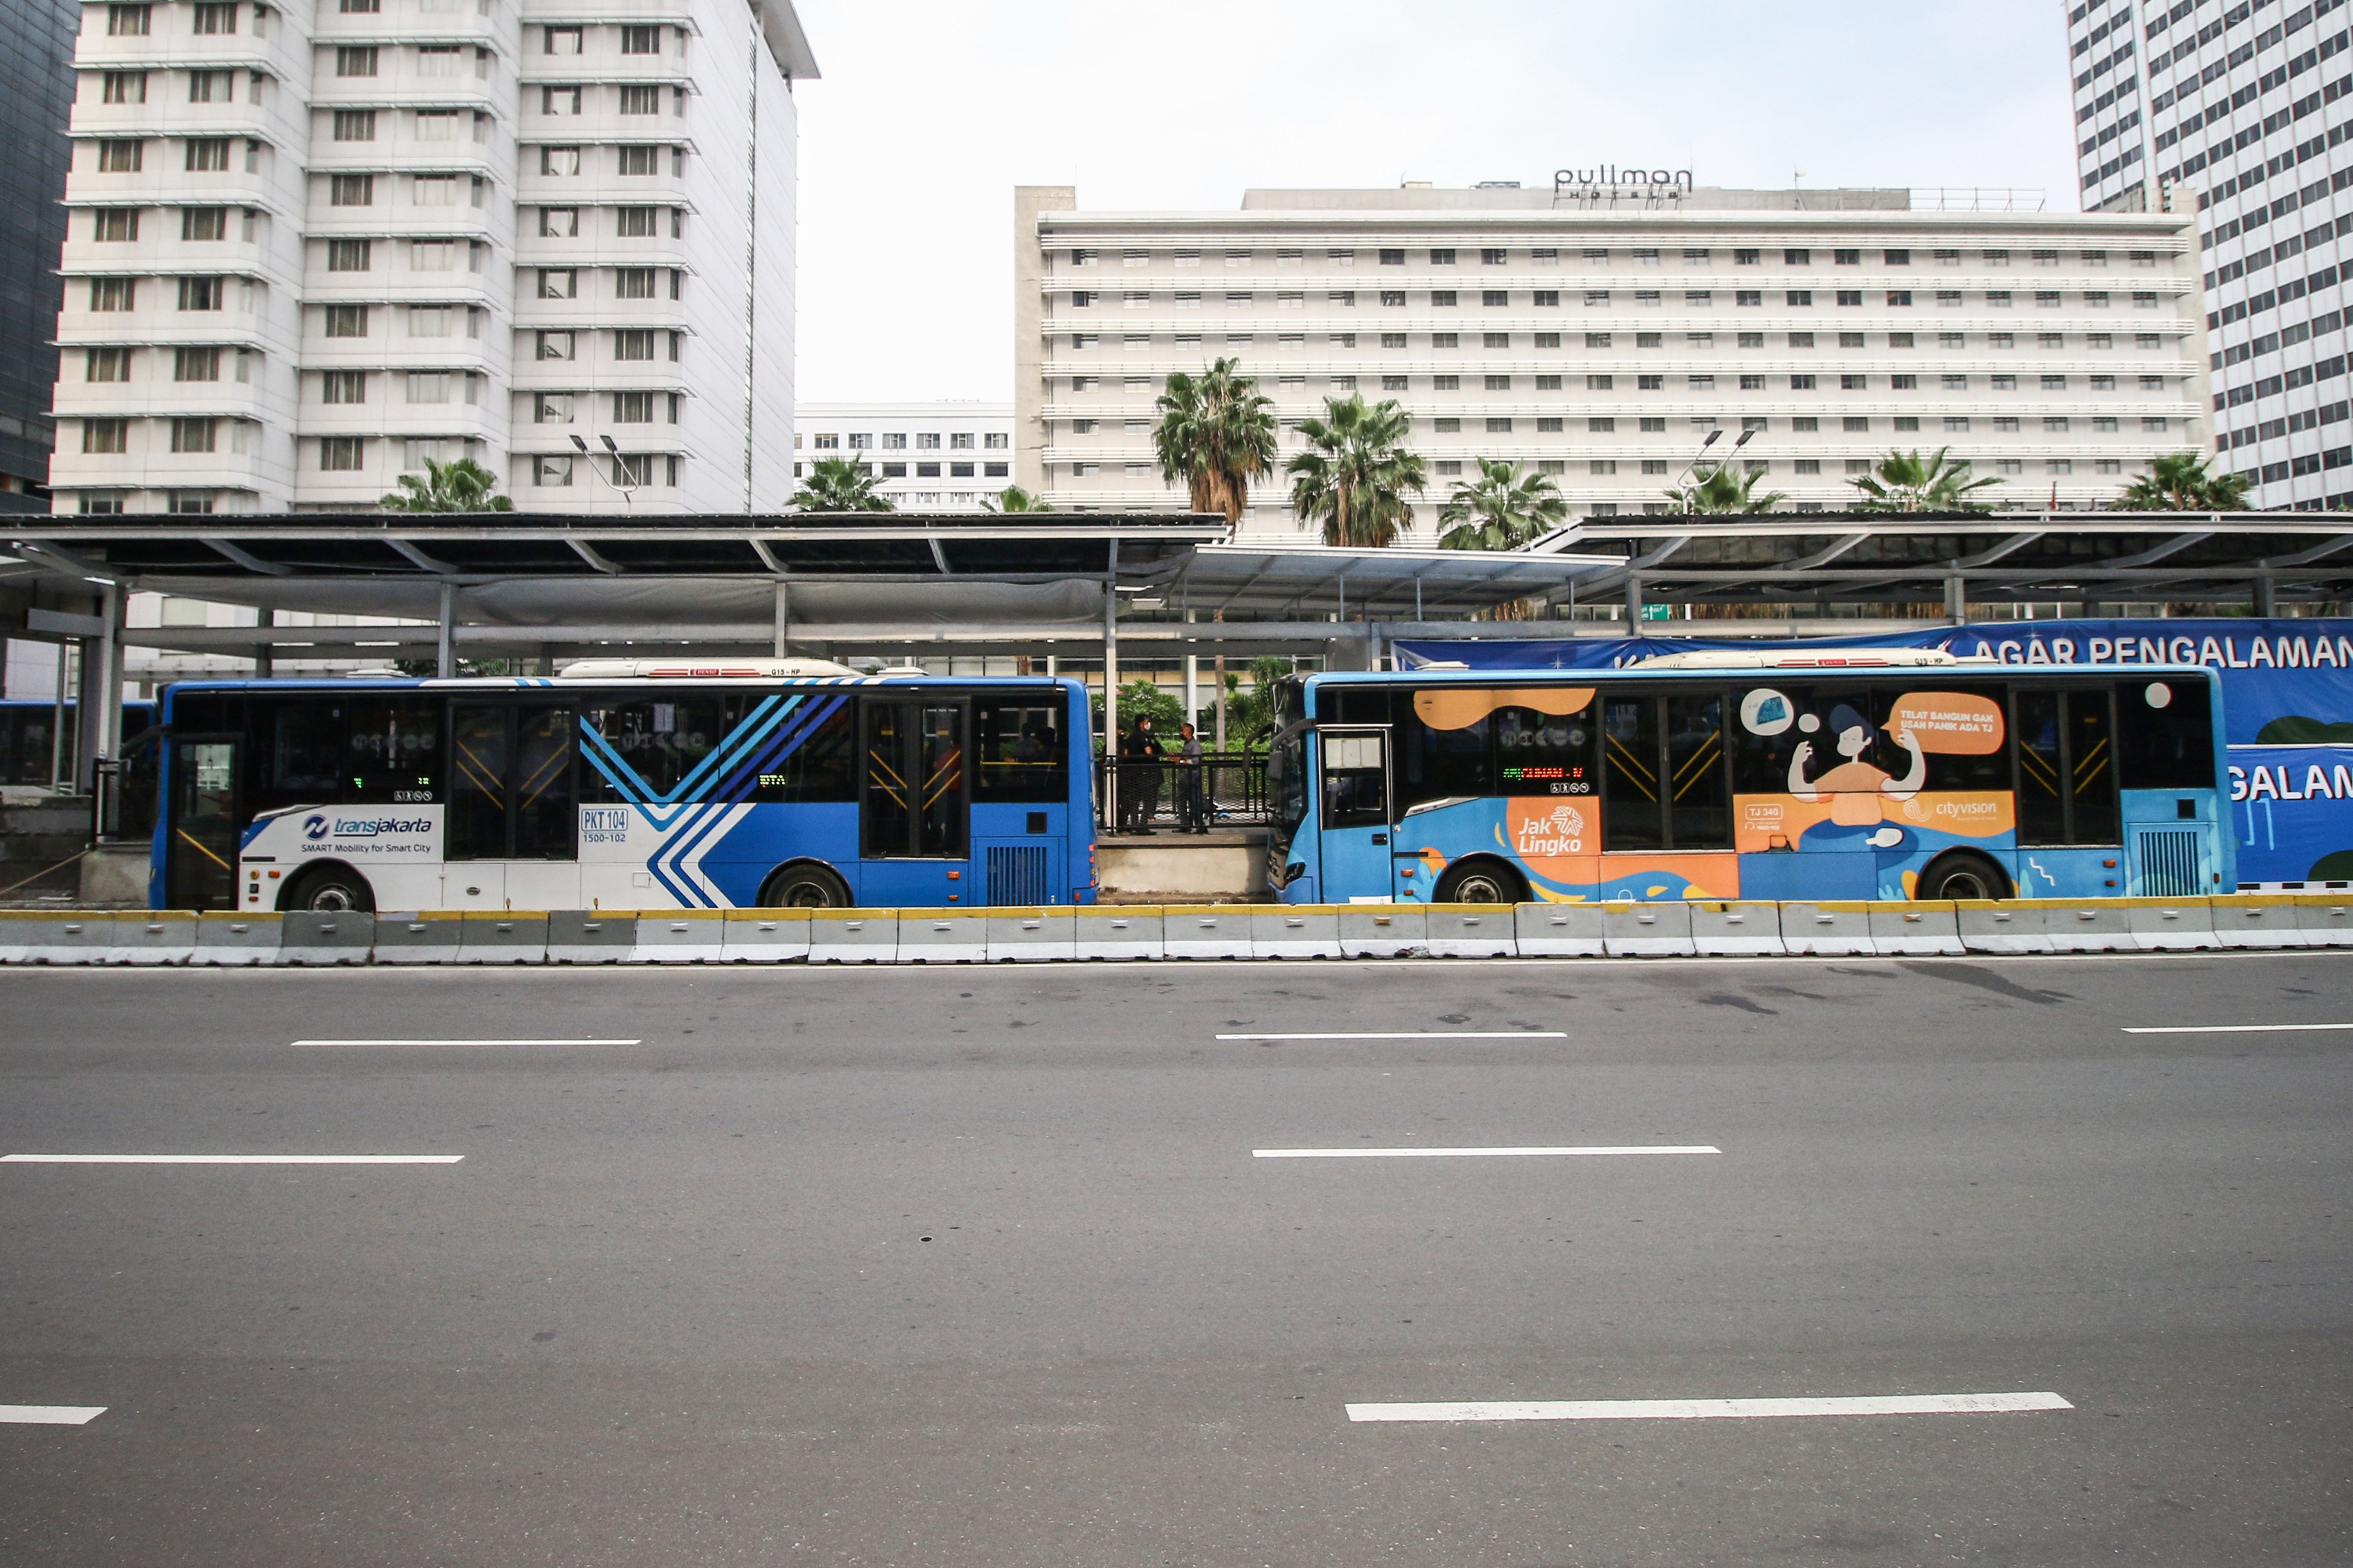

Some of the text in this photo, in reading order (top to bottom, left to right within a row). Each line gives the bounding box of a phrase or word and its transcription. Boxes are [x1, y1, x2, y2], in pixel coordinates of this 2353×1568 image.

[1554, 164, 1692, 193] pullman
[1975, 638, 2076, 664] AGAR
[1900, 710, 1993, 722] TELAT BANGUN GAK
[1928, 721, 1957, 731] PANIK
[1959, 723, 1979, 732] ADA
[1981, 724, 1993, 732] TJ
[1749, 808, 1778, 816] TJ 340
[1936, 802, 1996, 818] cityvision
[334, 818, 432, 837] transjakarta
[585, 811, 625, 829] PKT 104
[1518, 818, 1552, 835] Jak
[583, 834, 625, 842] 1500-102
[301, 844, 431, 853] SMART Mobility for Smart City
[1519, 836, 1581, 857] Lingko
